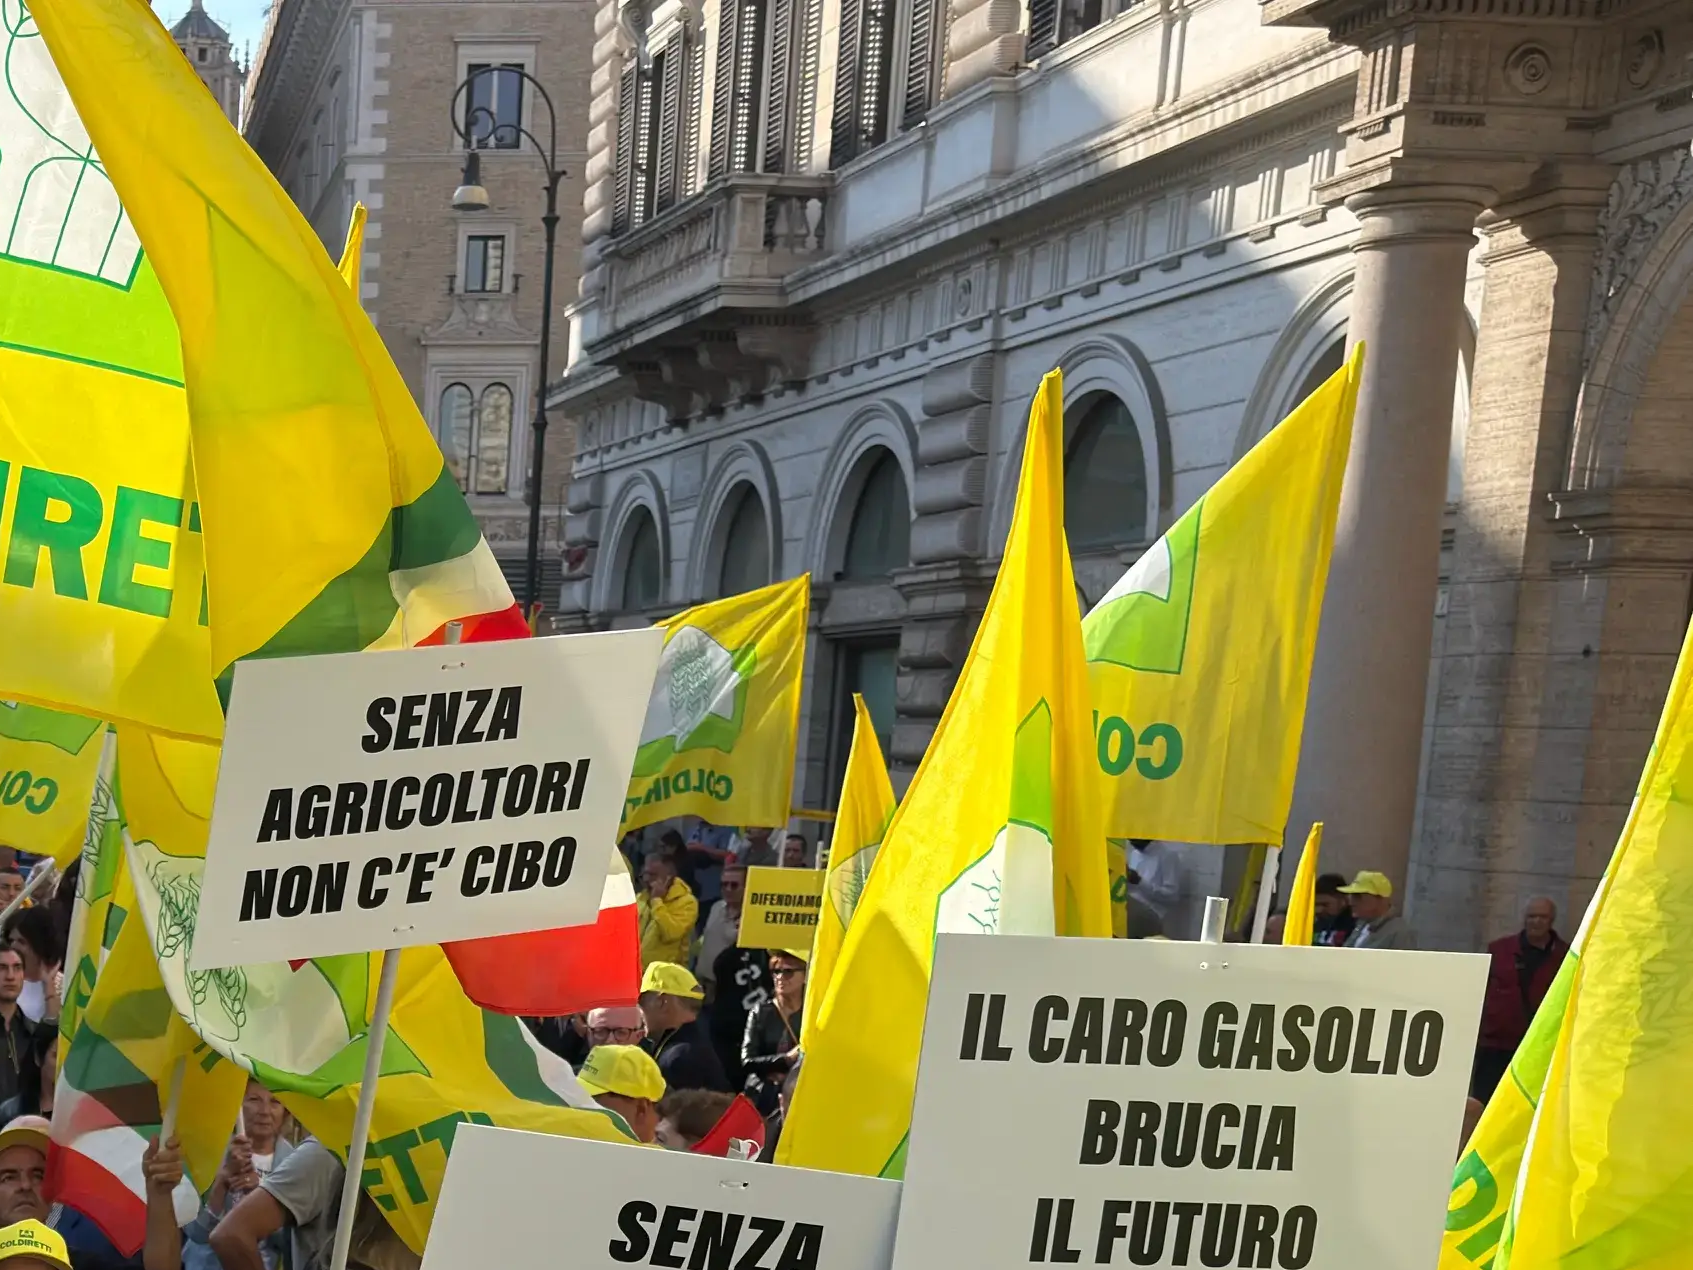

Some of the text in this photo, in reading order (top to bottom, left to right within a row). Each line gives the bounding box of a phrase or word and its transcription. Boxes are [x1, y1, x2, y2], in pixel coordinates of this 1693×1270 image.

[362, 686, 523, 754] SENZA
[257, 759, 591, 844] AGRICOLTORI
[239, 860, 350, 922] NON
[461, 836, 577, 898] CIBO
[960, 993, 1444, 1077] IL CARO GASOLIO
[1079, 1099, 1297, 1171] BRUCIA
[0, 1239, 52, 1253] COLDIRETTI
[1029, 1197, 1318, 1270] IL FUTURO
